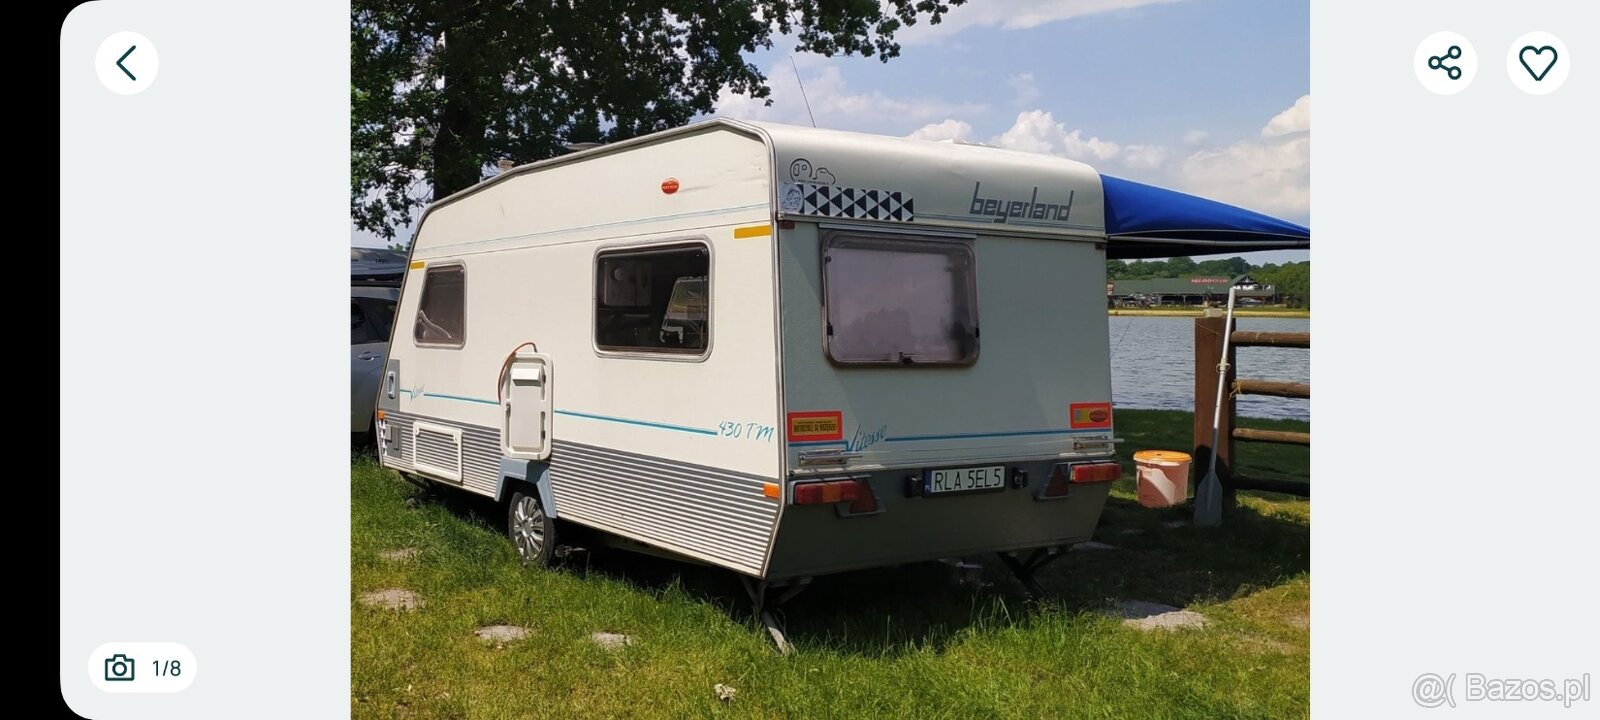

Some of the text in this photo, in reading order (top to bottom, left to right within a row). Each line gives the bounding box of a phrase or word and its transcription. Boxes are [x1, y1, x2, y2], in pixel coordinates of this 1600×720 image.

[969, 181, 1074, 224] beyerland
[718, 420, 775, 443] 430 TM
[846, 424, 888, 451] Vitesse
[934, 468, 1002, 491] RLA 5EL5
